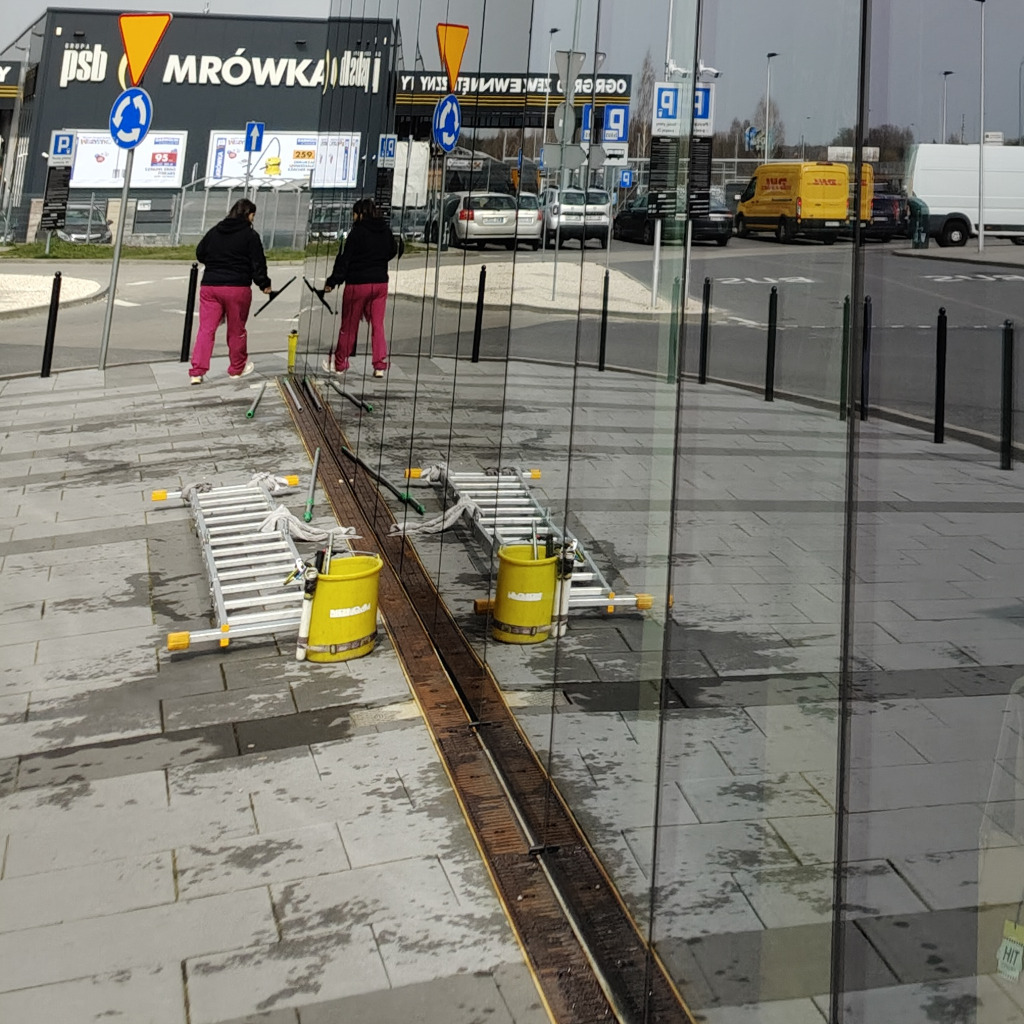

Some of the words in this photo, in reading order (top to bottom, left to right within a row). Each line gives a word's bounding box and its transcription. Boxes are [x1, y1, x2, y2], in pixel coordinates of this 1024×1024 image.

[59, 44, 108, 88] psb
[162, 48, 325, 88] MRÓWKA
[57, 136, 71, 153] P
[1002, 945, 1020, 966] HIT
